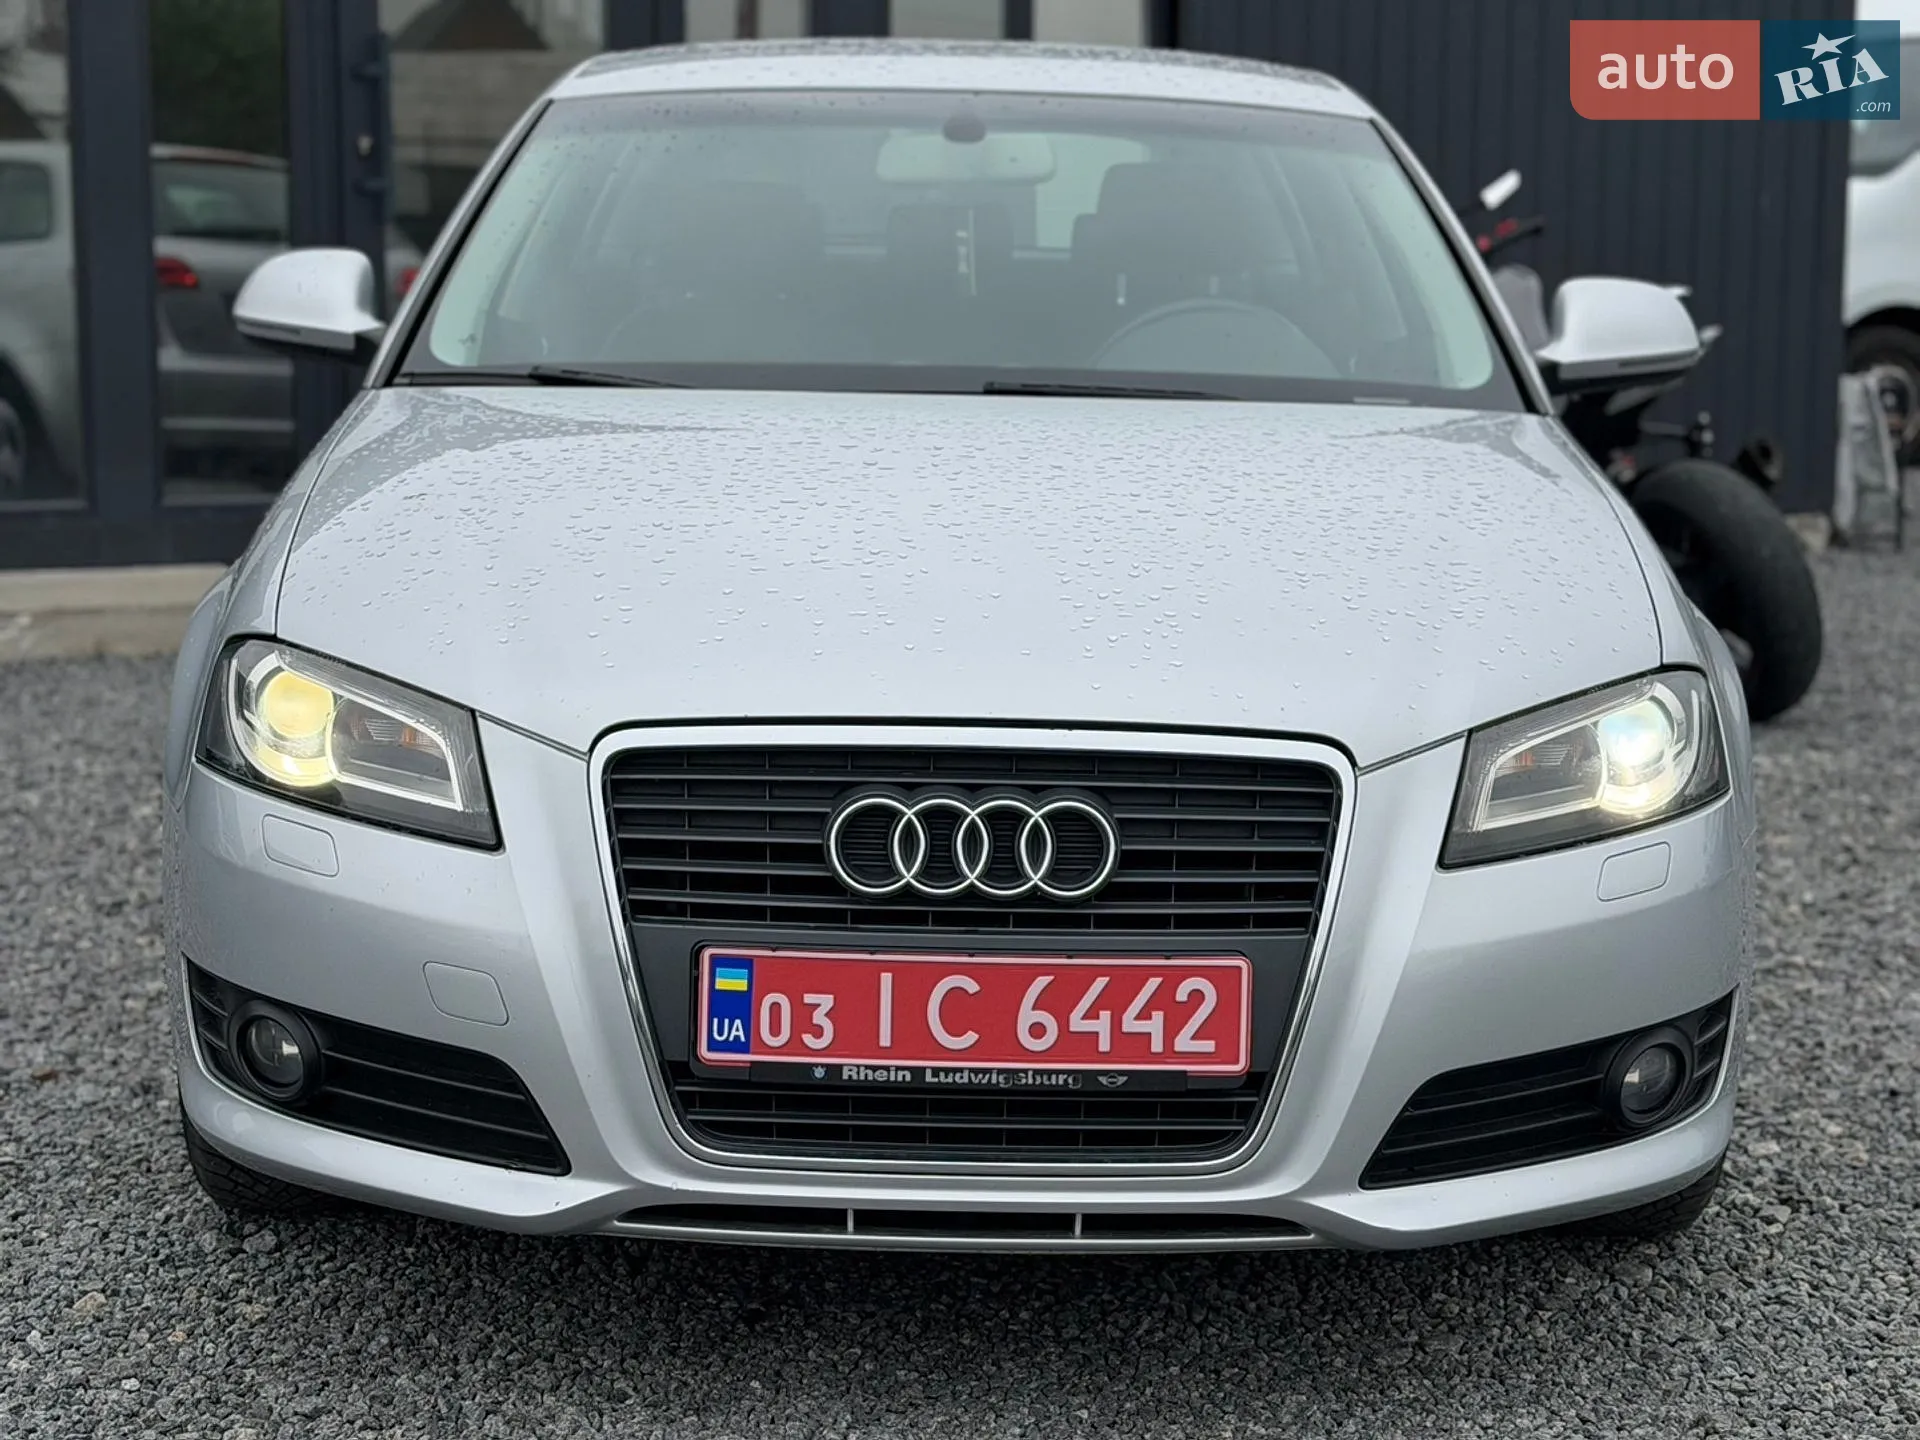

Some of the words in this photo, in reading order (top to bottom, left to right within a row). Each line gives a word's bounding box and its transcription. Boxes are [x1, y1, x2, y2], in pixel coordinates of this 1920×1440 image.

[758, 992, 835, 1050] 03
[1016, 975, 1218, 1053] 6442
[712, 1018, 746, 1042] UA
[842, 1064, 911, 1083] Rhein
[925, 1067, 1082, 1089] Ludwigsburg
